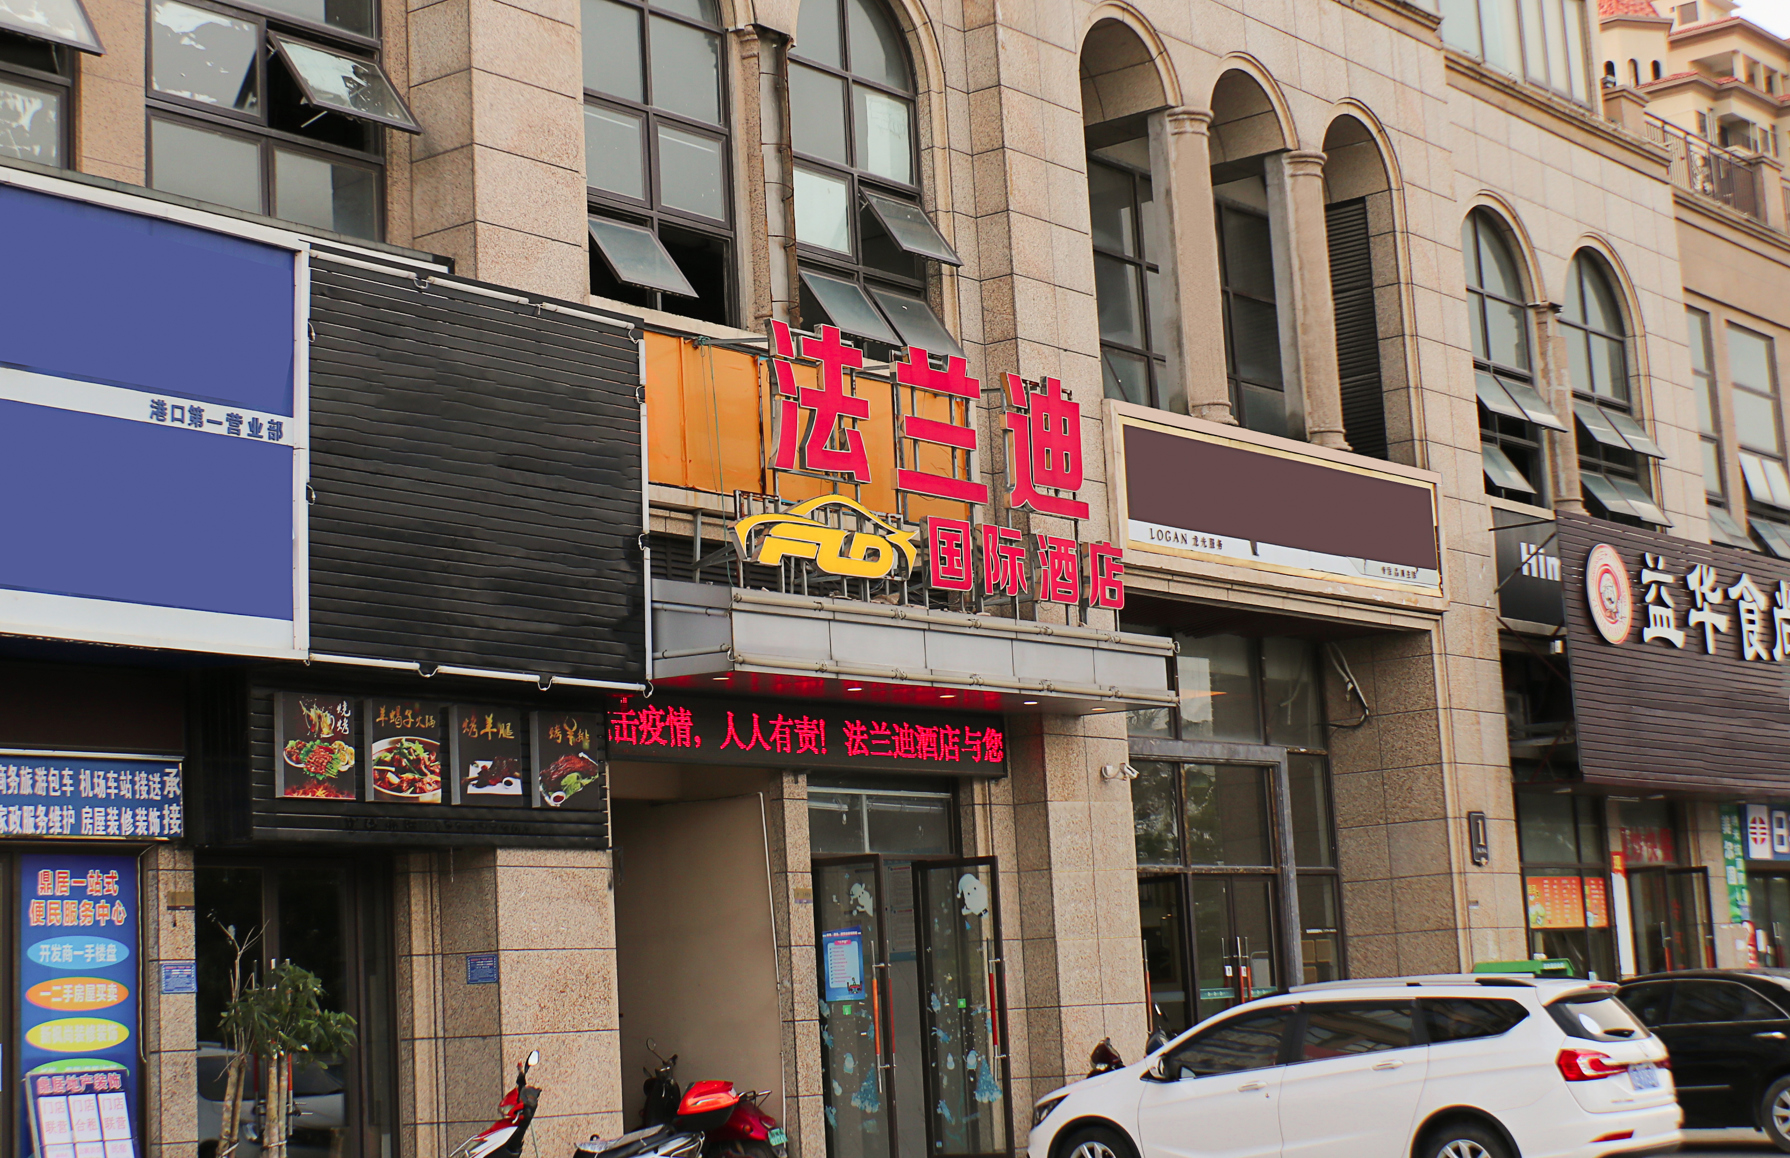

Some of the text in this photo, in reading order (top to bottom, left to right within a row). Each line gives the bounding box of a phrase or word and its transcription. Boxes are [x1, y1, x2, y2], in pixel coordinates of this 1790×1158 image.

[150, 399, 284, 441] 港口第一营业部
[764, 318, 1089, 520] 法兰迪
[1149, 527, 1188, 545] LOGAN
[921, 515, 1125, 611] 国际酒店
[462, 712, 515, 741] 烤羊腿
[79, 768, 162, 801] 机场车站接送
[81, 805, 161, 836] 房屋装修装饰
[37, 869, 119, 896] 鼎居一站式
[29, 899, 127, 927] 便民服务中心
[39, 943, 117, 963] 开发商一手楼盘
[40, 984, 118, 1003] 一二手房屋买卖
[36, 1072, 122, 1095] 鼎居地产装饰
[43, 1101, 66, 1115] 门店
[72, 1099, 95, 1112] 门店
[102, 1097, 124, 1111] 门店
